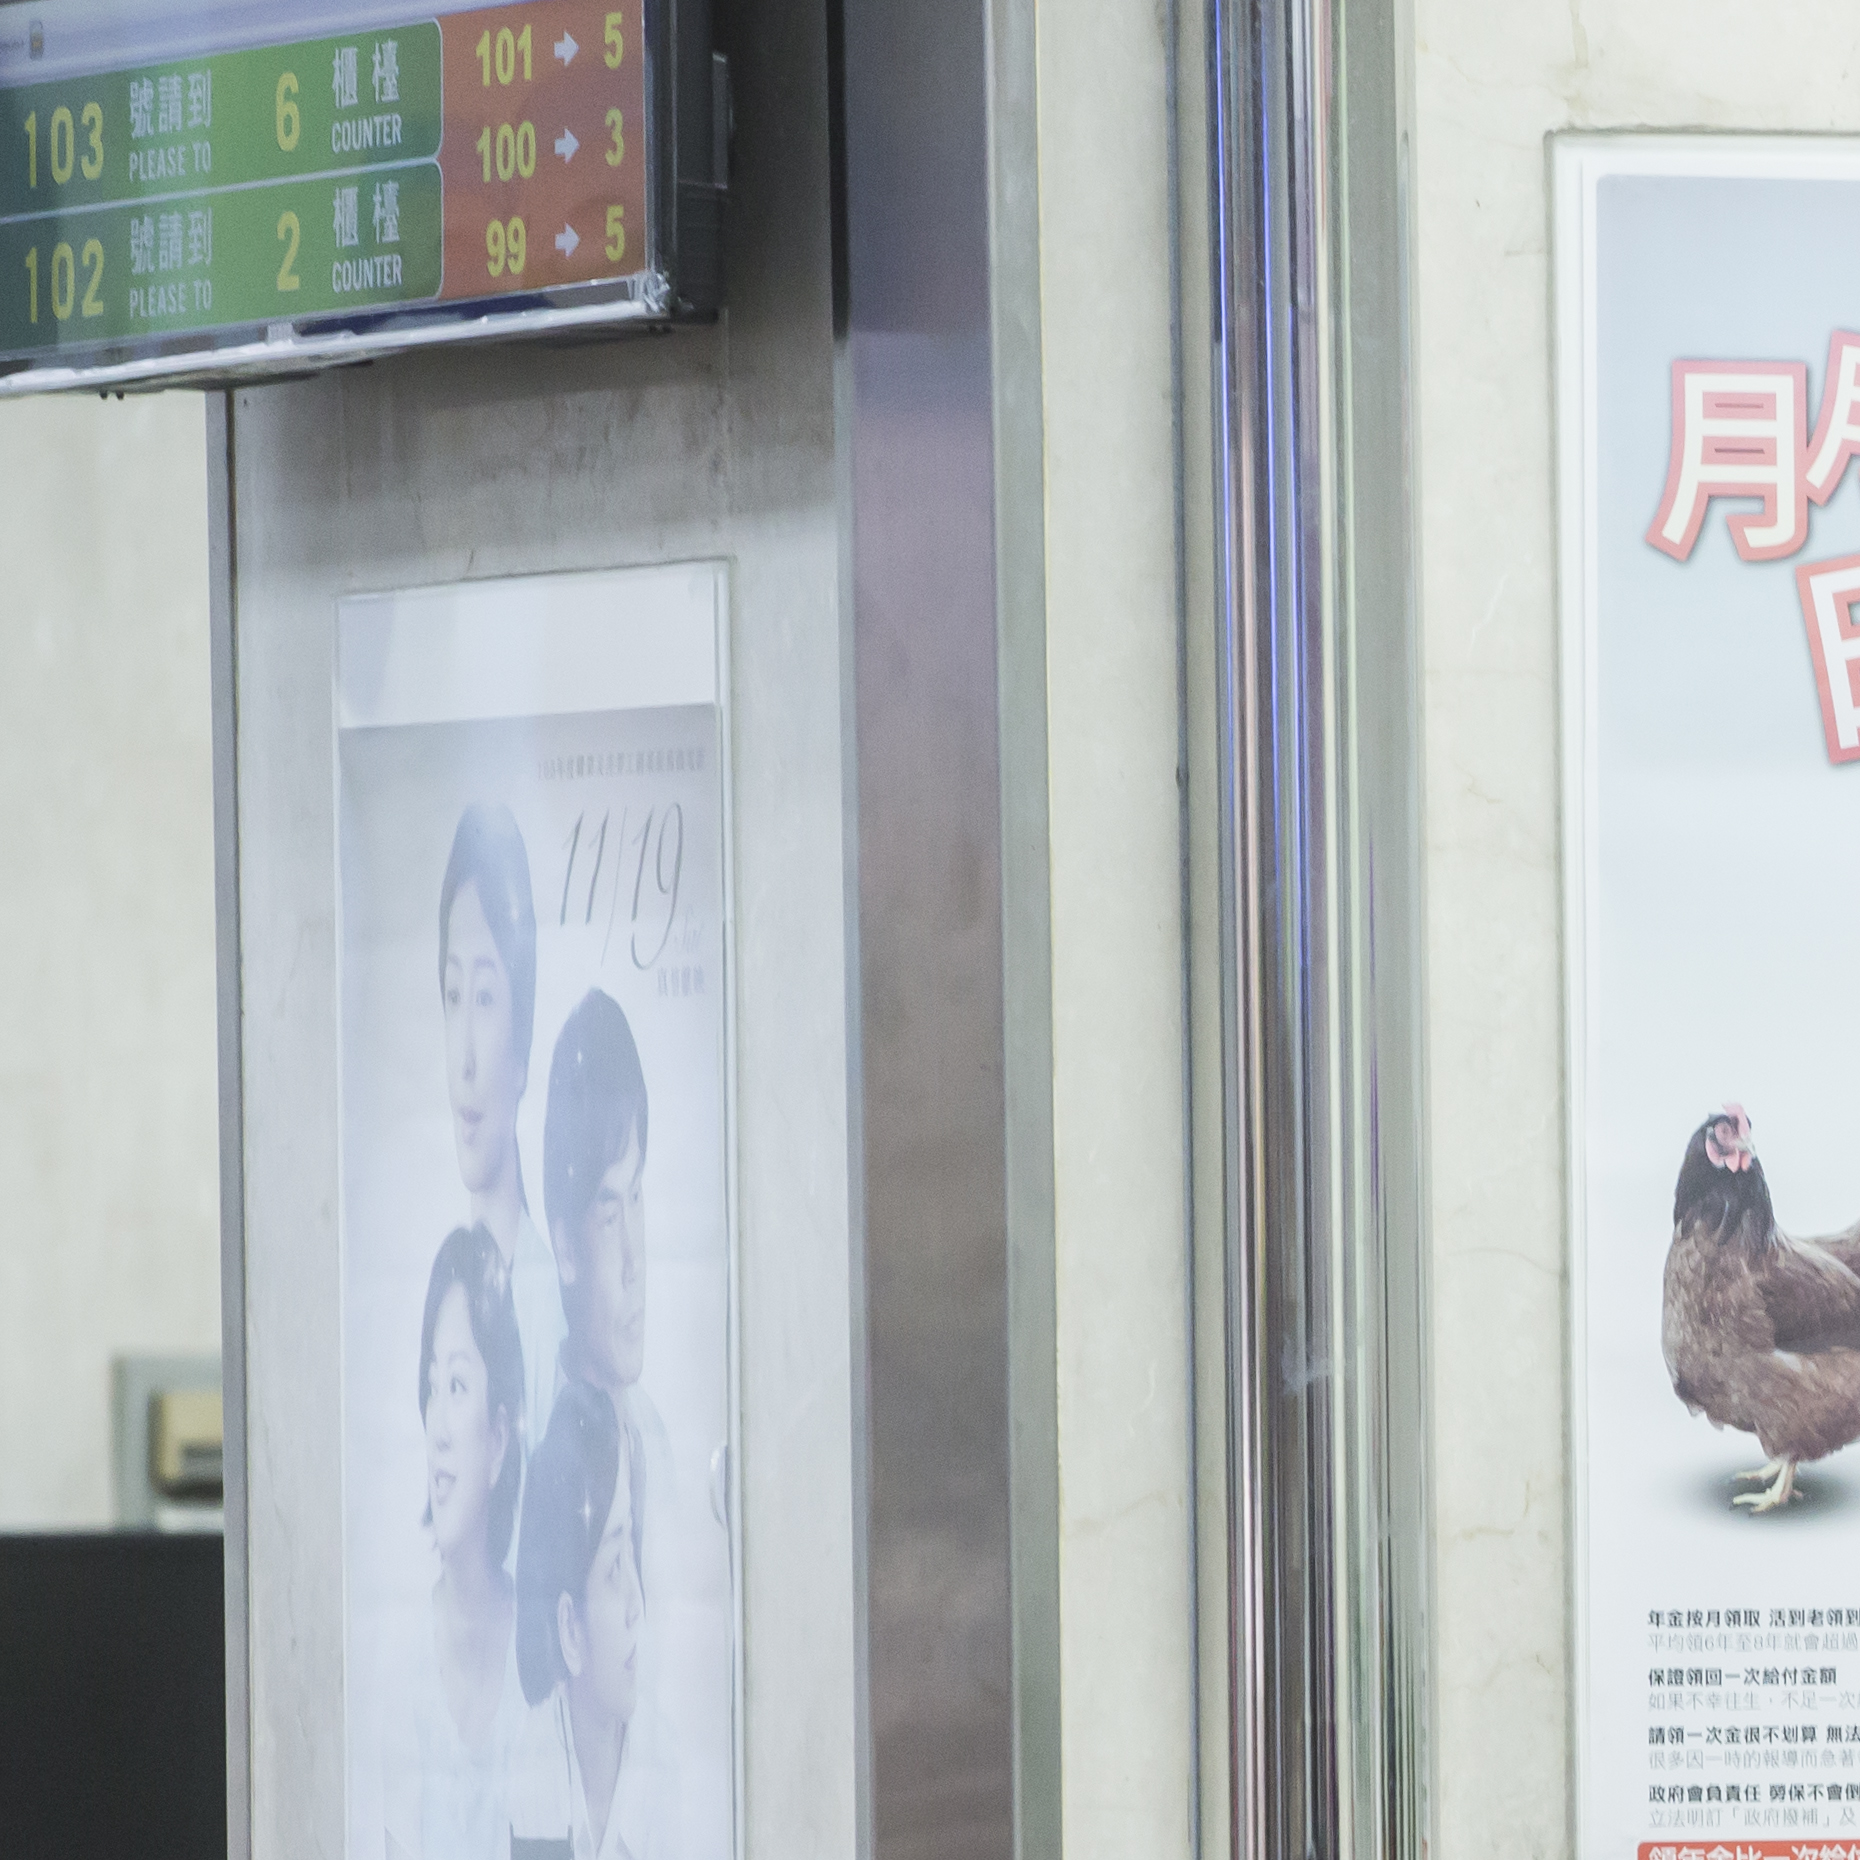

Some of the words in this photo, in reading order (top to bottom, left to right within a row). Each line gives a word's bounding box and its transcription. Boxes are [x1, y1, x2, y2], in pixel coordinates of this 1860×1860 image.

[475, 24, 534, 87] 101
[603, 12, 625, 69] 5
[24, 101, 104, 190] 103
[129, 69, 212, 139] 號請到
[276, 72, 300, 152] 6
[129, 149, 187, 183] PLEASE
[193, 146, 212, 174] TO
[331, 113, 403, 154] COUNTER
[477, 121, 537, 183] 100
[604, 108, 625, 167] 3
[24, 239, 104, 325] 102
[129, 207, 212, 276] 號請到
[276, 211, 300, 292] 2
[486, 216, 528, 278] 99
[604, 205, 626, 262] 5
[129, 289, 187, 320] PLEASE
[193, 285, 212, 312] TO
[331, 254, 403, 294] COUNTER
[559, 801, 684, 971] 11/19
[1648, 1608, 1761, 1629] 年金按月領取
[1648, 1666, 1838, 1688] 保證領回一次給付金額
[1648, 1724, 1818, 1745] 請領一次金很不划算
[1648, 1783, 1761, 1804] 政府會負責任
